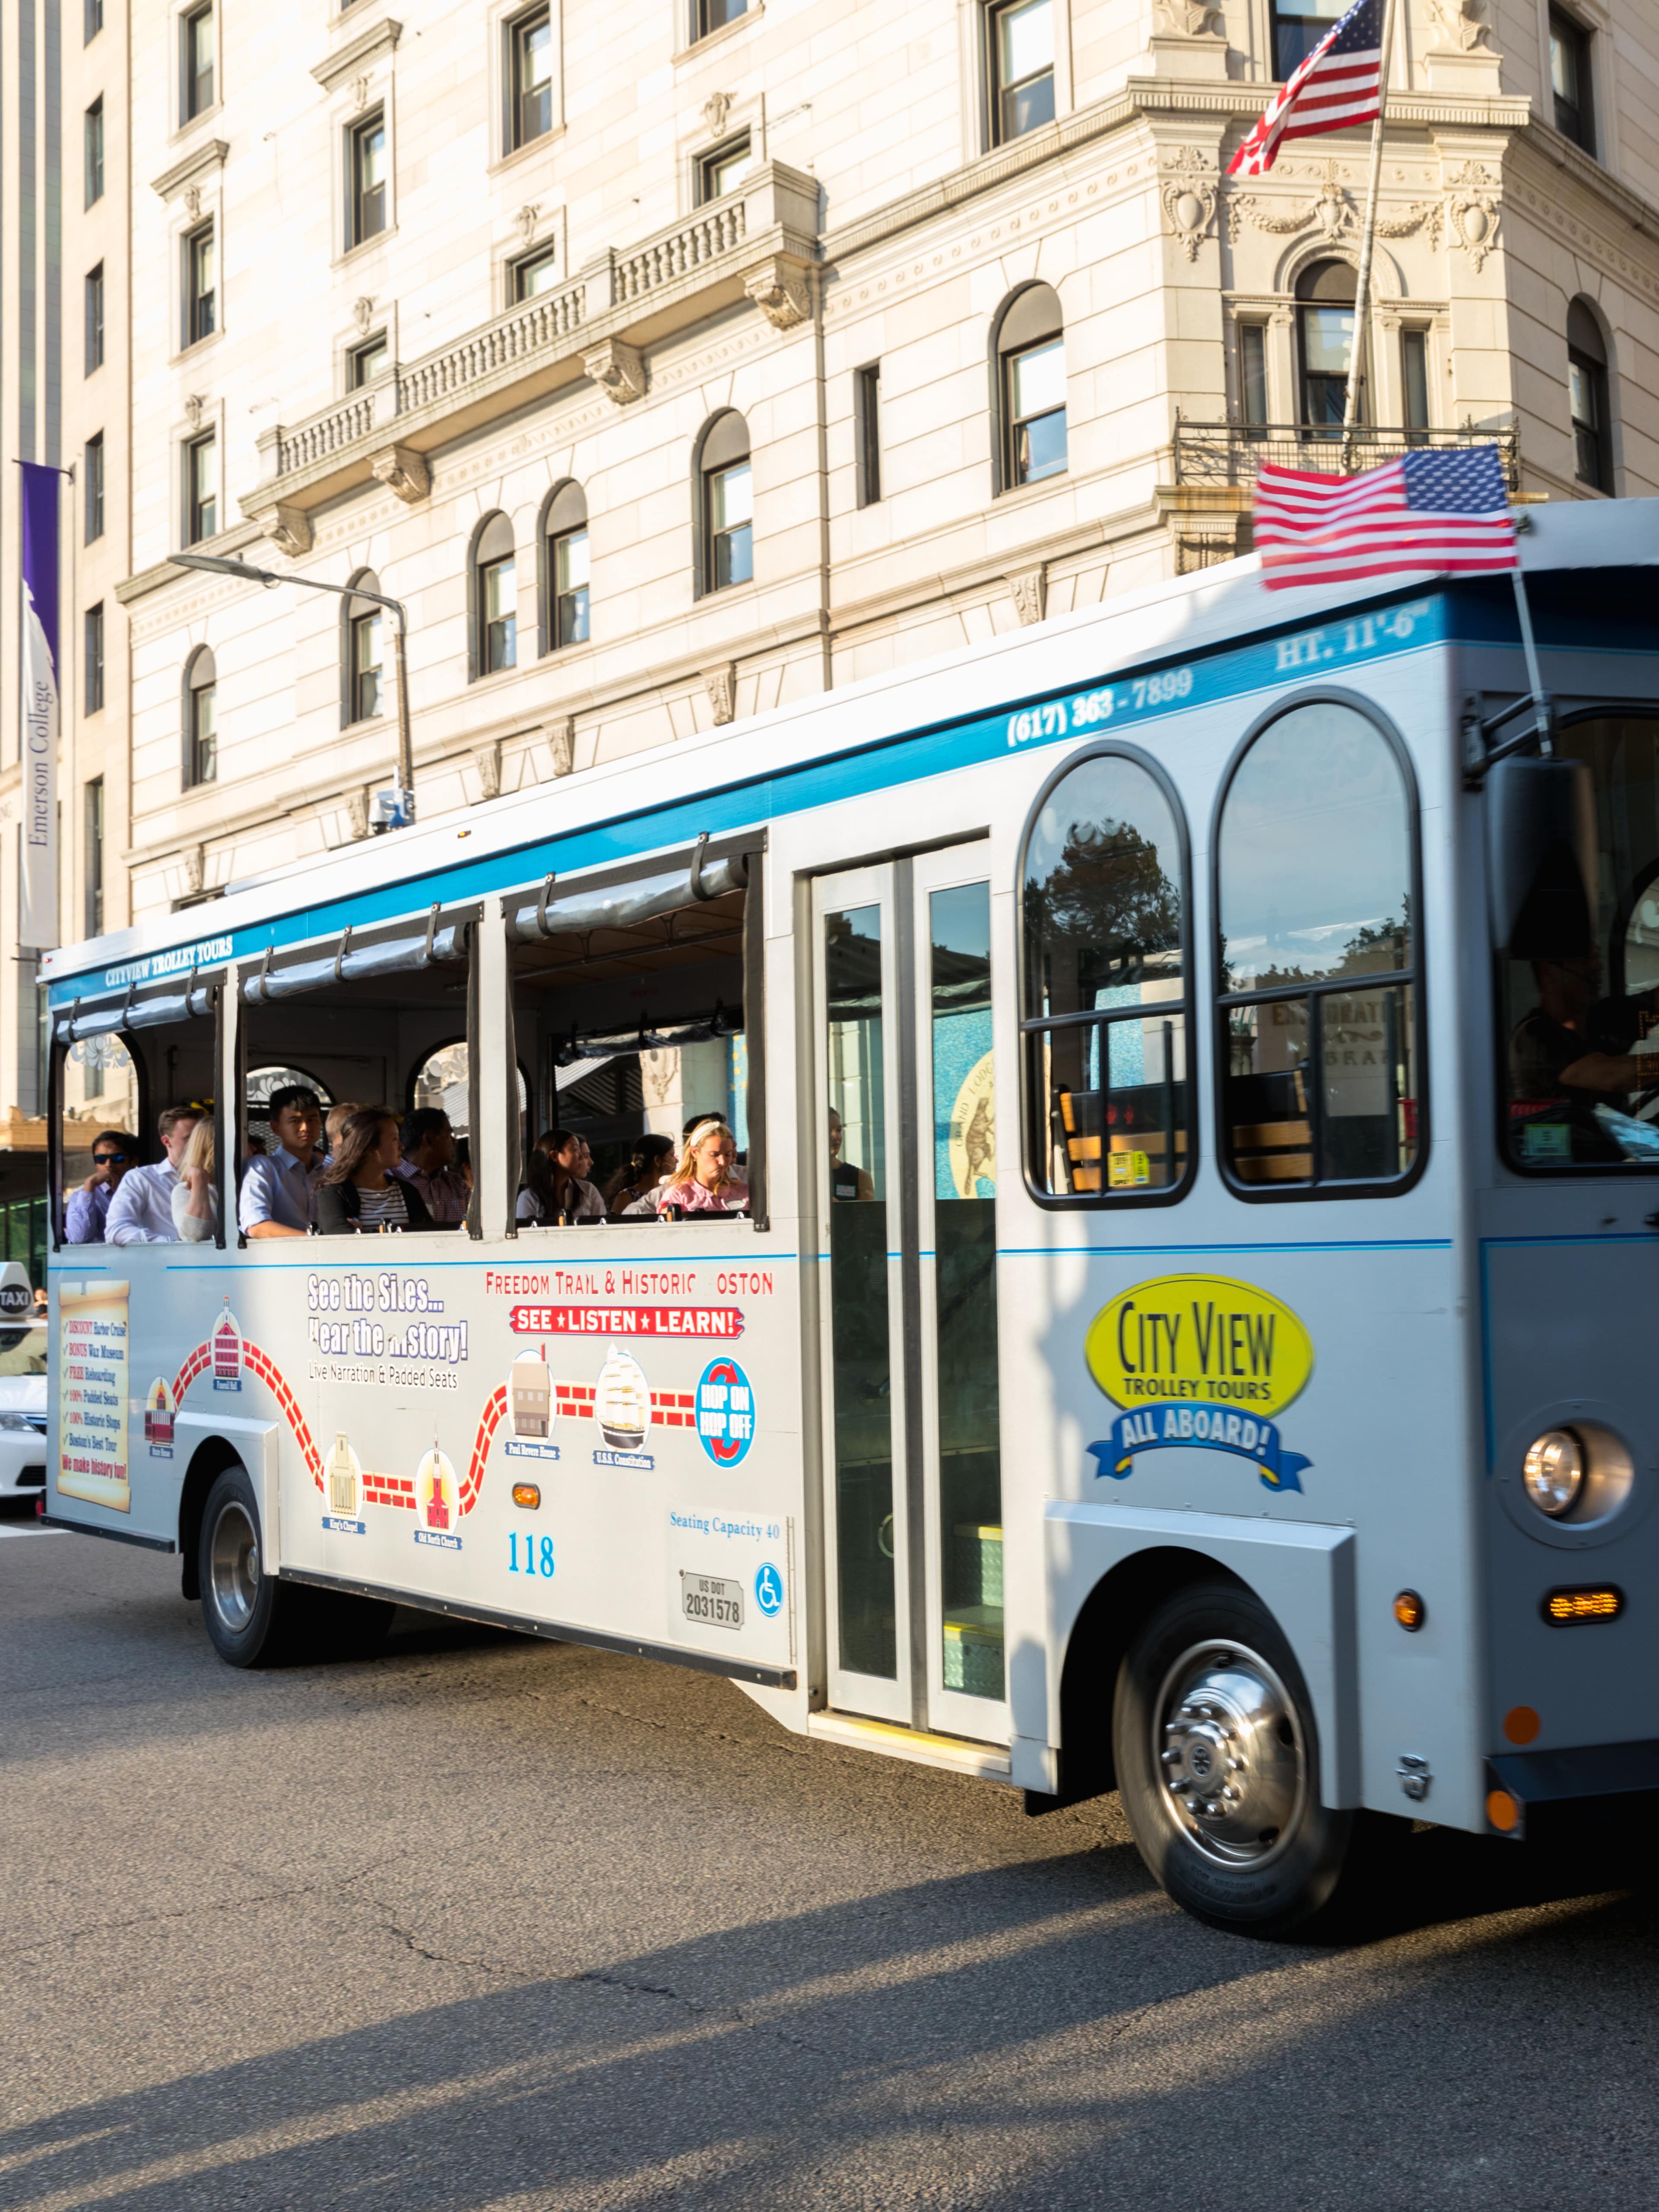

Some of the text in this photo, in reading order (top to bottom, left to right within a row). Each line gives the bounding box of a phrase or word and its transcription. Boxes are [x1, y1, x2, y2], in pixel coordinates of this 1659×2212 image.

[1275, 631, 1333, 670] HT.
[1007, 701, 1067, 747] (617)
[1072, 688, 1114, 727] 363
[1132, 668, 1193, 709] 7899
[28, 681, 54, 846] Emerson College
[105, 935, 233, 987] CITYVIEW TROLLEY TOURS
[968, 1058, 994, 1095] LODG
[308, 1274, 340, 1311] See
[344, 1274, 375, 1311] the
[486, 1271, 549, 1294] FREEDOM
[556, 1271, 598, 1294] TRAIL
[605, 1270, 615, 1294] &
[717, 1272, 773, 1295] OSTON
[0, 1291, 29, 1306] TAXI
[69, 1320, 126, 1336] DISCOUNT Harbor Cruise
[518, 1309, 734, 1334] SEE LISTEN LEARN!
[353, 1318, 384, 1357] the
[1117, 1301, 1277, 1377] CITY VIEW
[69, 1343, 124, 1360] BONUS Wax Museum
[69, 1366, 115, 1386] FREE Reboarding
[309, 1362, 457, 1389] Live Narration & Padded Seats
[69, 1389, 118, 1406] 100% Padded Seats
[701, 1384, 750, 1411] HOP ON
[1123, 1378, 1271, 1400] TROLLEY TOURS
[84, 1412, 105, 1427] Historic
[106, 1414, 121, 1433] Stops
[700, 1411, 752, 1440] HOP OFF
[1121, 1408, 1271, 1456] ALL ABOARD!
[69, 1433, 117, 1452] Boston's Best Tour
[509, 1443, 556, 1459] Paul Revere House
[62, 1454, 126, 1480] We make history fun!
[596, 1452, 652, 1468] U.S.S. Constitution
[418, 1532, 427, 1543] Old
[670, 1512, 780, 1541] Seating Capacity 40
[509, 1531, 555, 1578] 118
[699, 1579, 725, 1595] US DOT
[686, 1592, 740, 1623] 2031578
